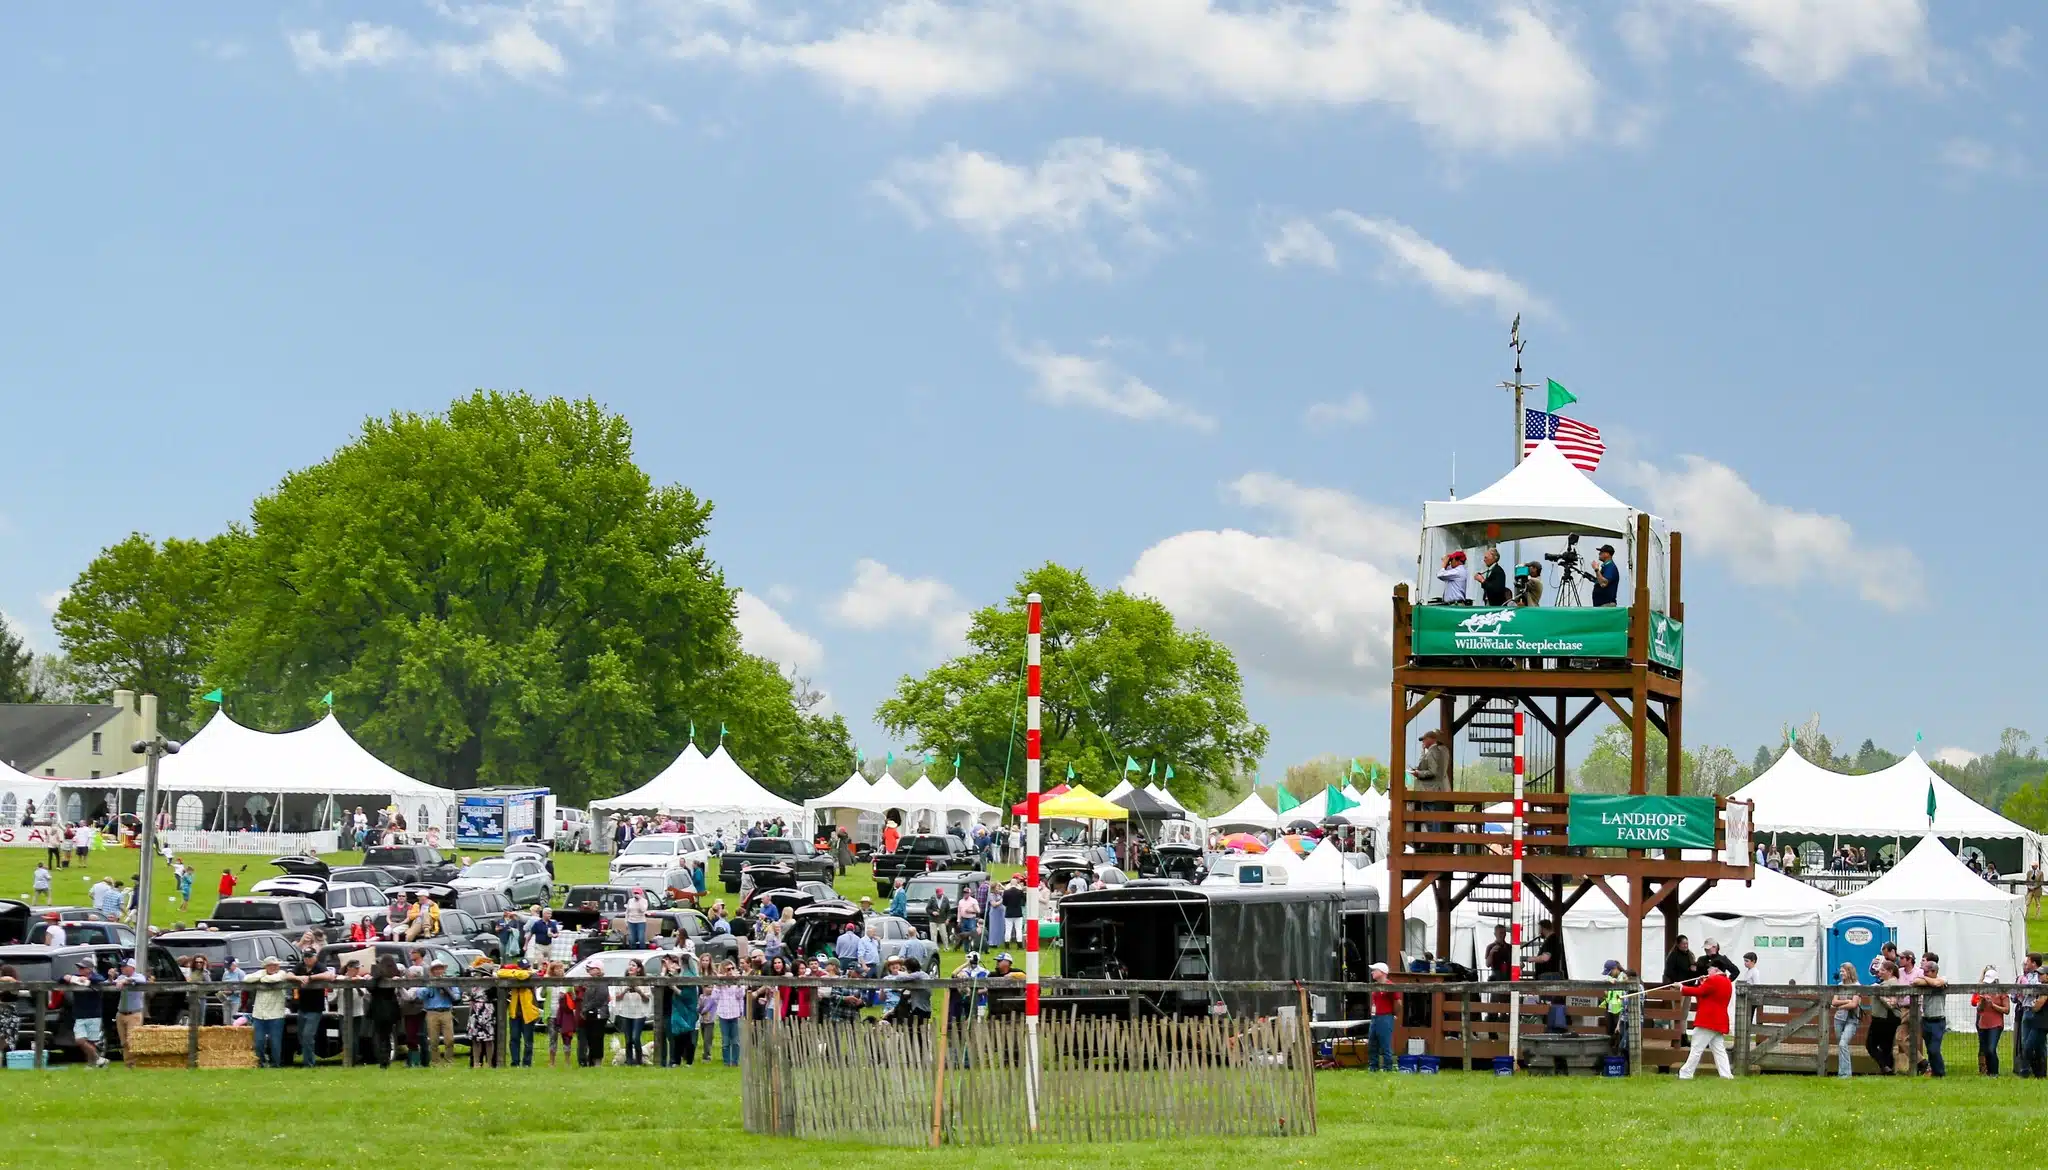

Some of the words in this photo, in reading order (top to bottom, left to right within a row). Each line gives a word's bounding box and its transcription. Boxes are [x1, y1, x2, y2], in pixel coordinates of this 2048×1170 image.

[1455, 639, 1513, 649] Willowdale
[1516, 639, 1583, 653] Steeplechase
[1602, 813, 1687, 826] LANDHOPE
[1617, 827, 1669, 840] FARMS
